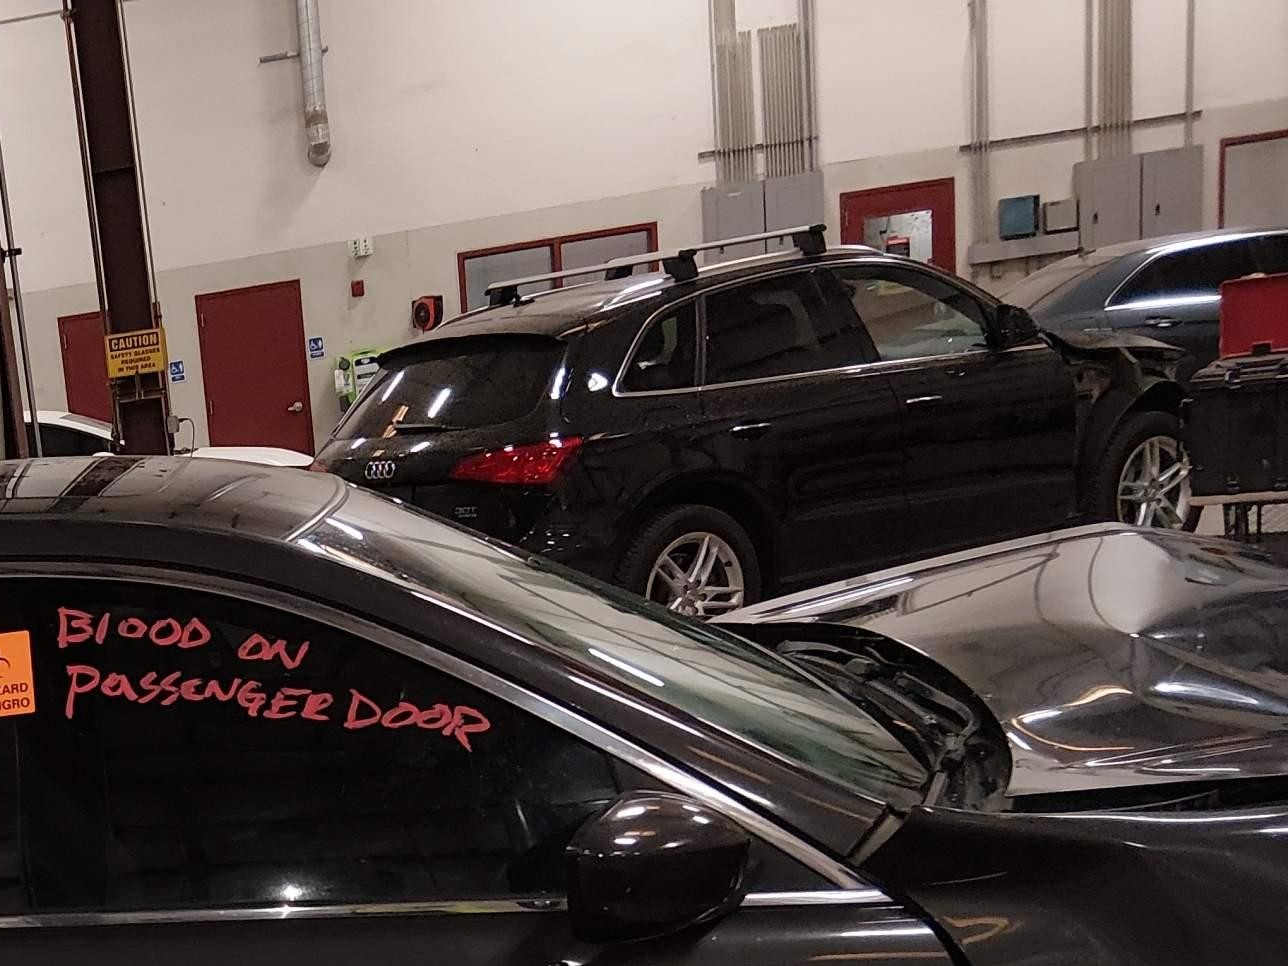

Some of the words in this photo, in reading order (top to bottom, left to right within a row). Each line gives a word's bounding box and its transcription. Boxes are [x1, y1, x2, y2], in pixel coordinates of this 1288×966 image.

[111, 333, 158, 351] CAUTION
[110, 351, 132, 360] SAFETY
[134, 347, 160, 357] GLASSES
[120, 356, 152, 365] REQUIRED
[237, 632, 310, 669] ON
[343, 688, 491, 752] DOOR
